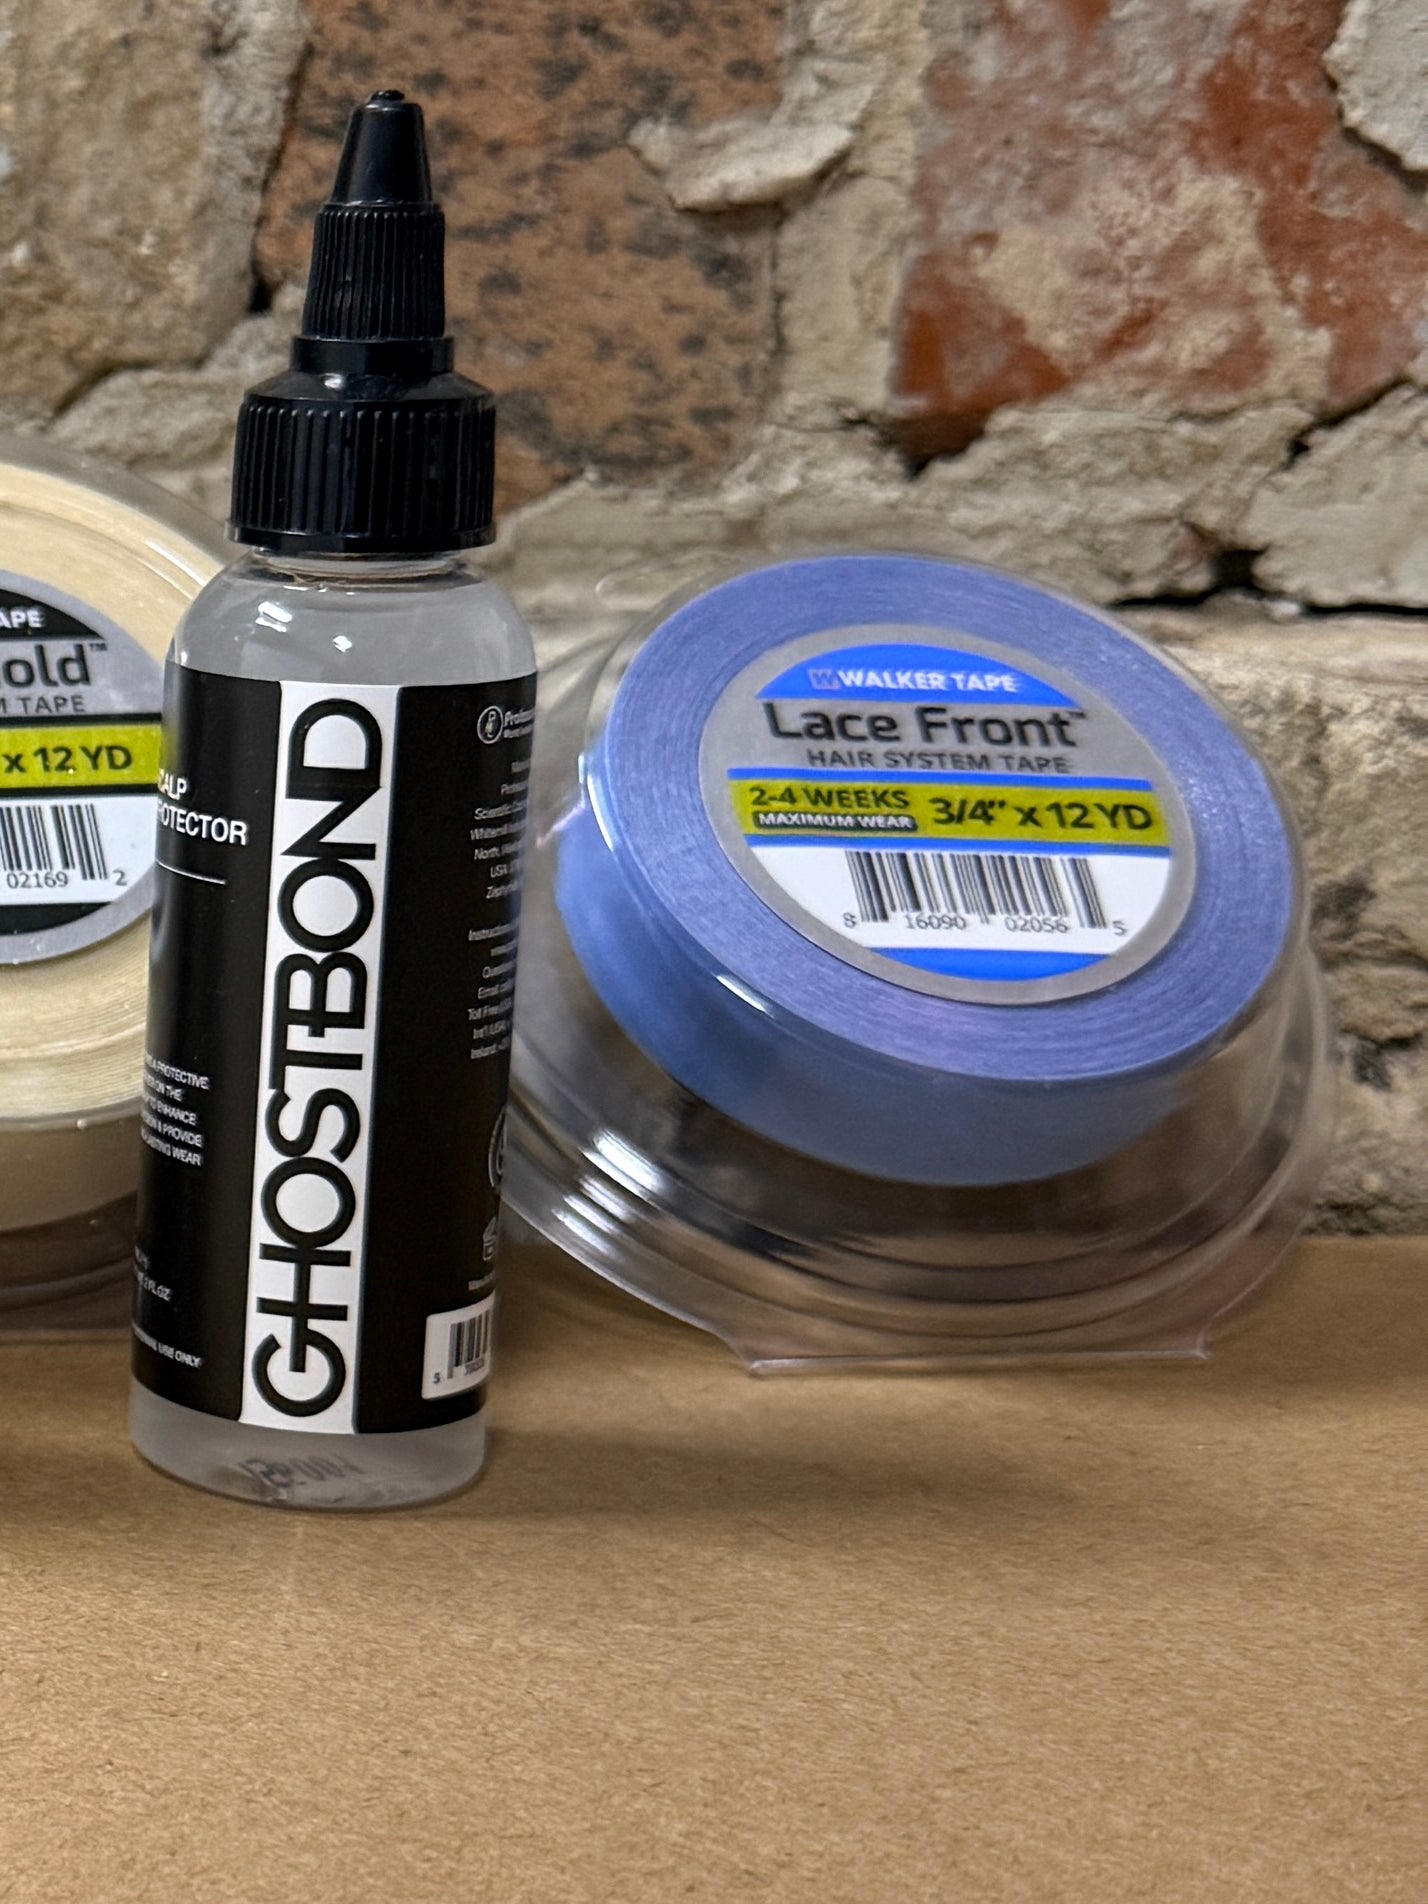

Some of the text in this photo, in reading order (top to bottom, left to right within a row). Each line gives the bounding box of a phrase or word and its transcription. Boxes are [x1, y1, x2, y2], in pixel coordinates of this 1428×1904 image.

[838, 669, 1017, 693] WALKER TAPE
[17, 694, 87, 715] TAPE
[764, 702, 899, 744] Lace
[2, 752, 26, 775] x
[34, 747, 75, 773] 12
[80, 744, 133, 772] YD
[806, 748, 1072, 774] HAIR SYSTEM TAPE
[750, 786, 910, 809] 2-4 WEEKS
[758, 813, 913, 830] MAXIMUM WEAR
[1014, 805, 1043, 828] x
[1045, 804, 1094, 829] 12
[1097, 804, 1153, 832] YD
[6, 872, 69, 890] 02169
[114, 869, 127, 888] 2
[905, 914, 1068, 934] 16090 02056
[251, 698, 382, 1417] GHOSTBOND
